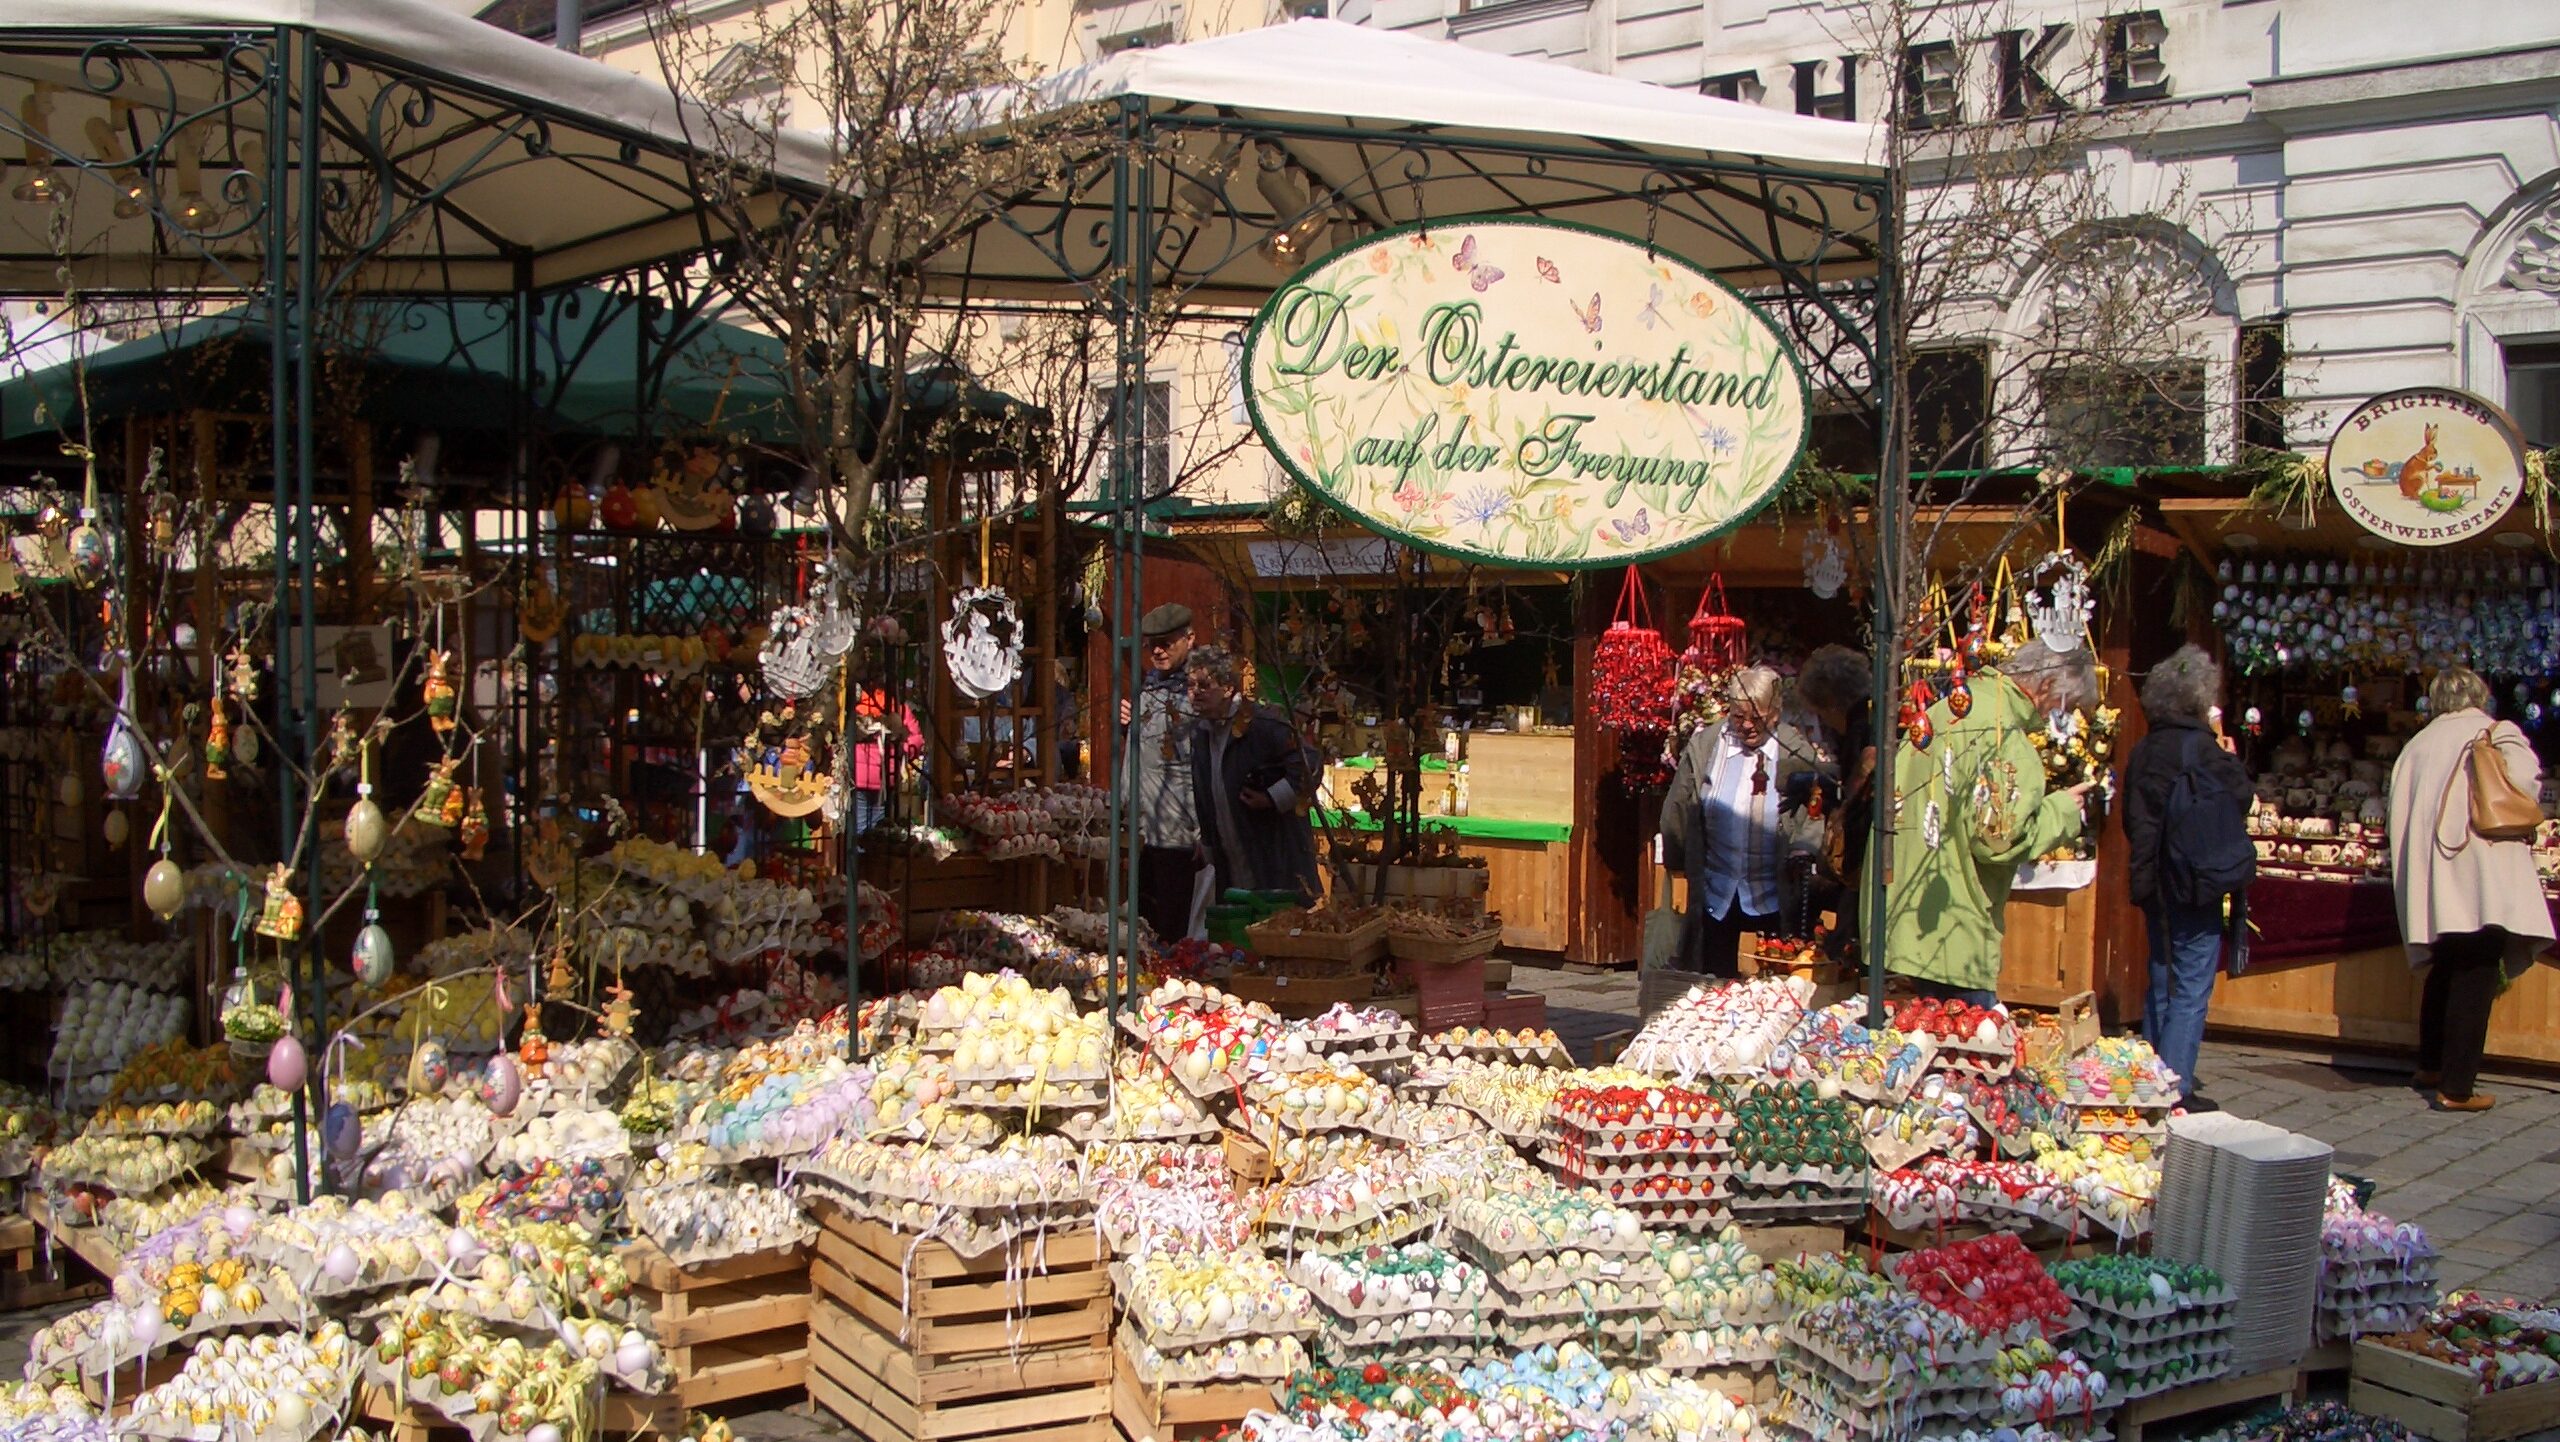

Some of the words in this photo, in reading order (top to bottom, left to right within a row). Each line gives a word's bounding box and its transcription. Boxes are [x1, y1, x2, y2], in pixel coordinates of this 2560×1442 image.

[1275, 284, 1399, 381] Der
[1419, 299, 1785, 409] Ostereierstand
[2354, 394, 2491, 431] BRIGITTES
[1353, 412, 1438, 492] auf
[1431, 414, 1500, 474] der
[1518, 414, 1711, 512] Freyung
[2342, 486, 2512, 539] OSTERWERKSTATT
